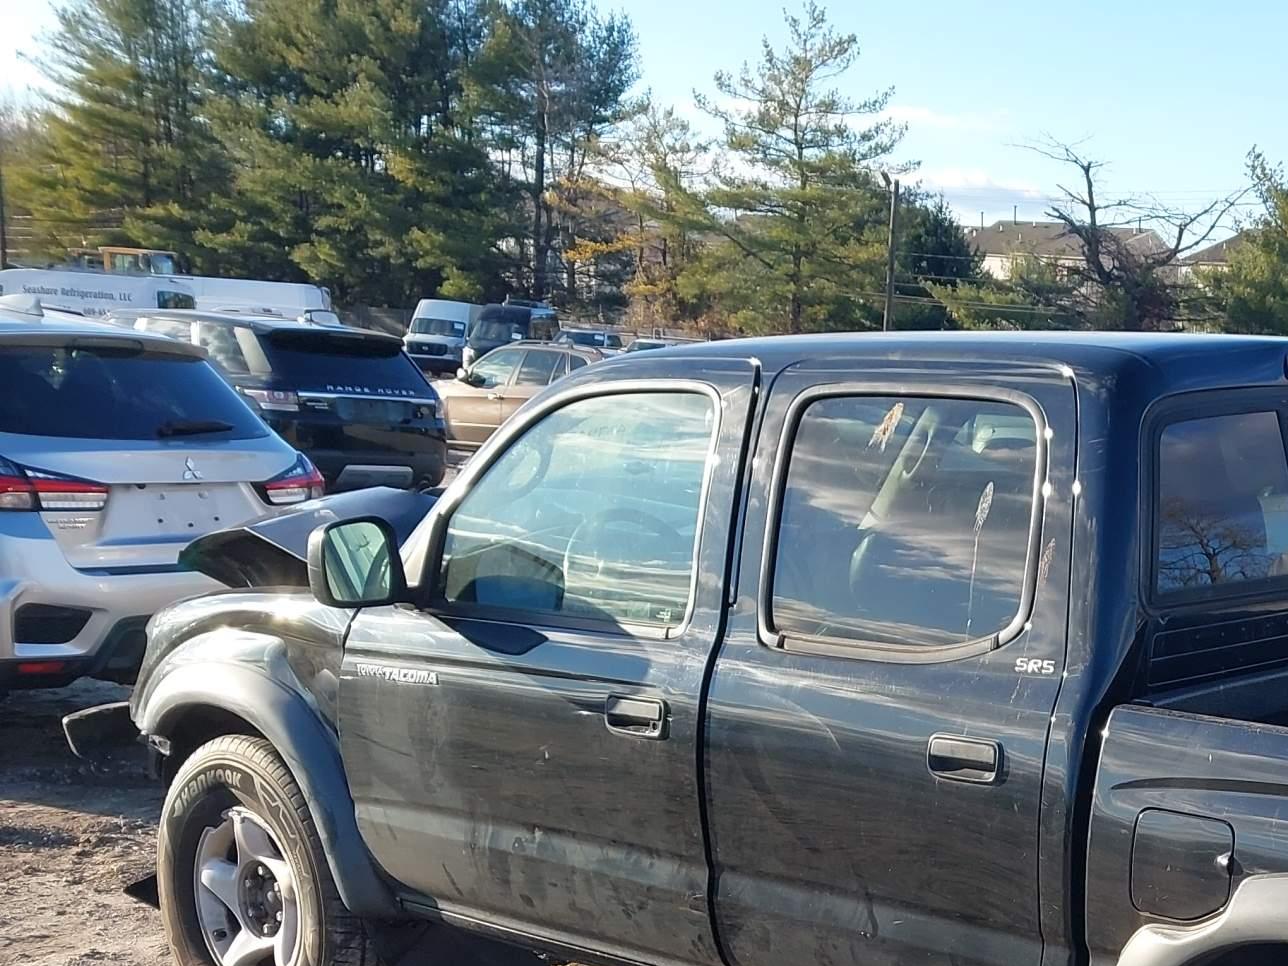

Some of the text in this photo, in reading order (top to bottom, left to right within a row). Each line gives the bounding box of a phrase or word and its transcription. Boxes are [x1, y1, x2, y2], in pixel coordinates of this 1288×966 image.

[22, 285, 58, 296] Seashore
[119, 292, 133, 302] LLC
[326, 384, 416, 397] RANGE ROVER
[1014, 657, 1056, 674] SR5
[382, 667, 439, 685] TACOMA
